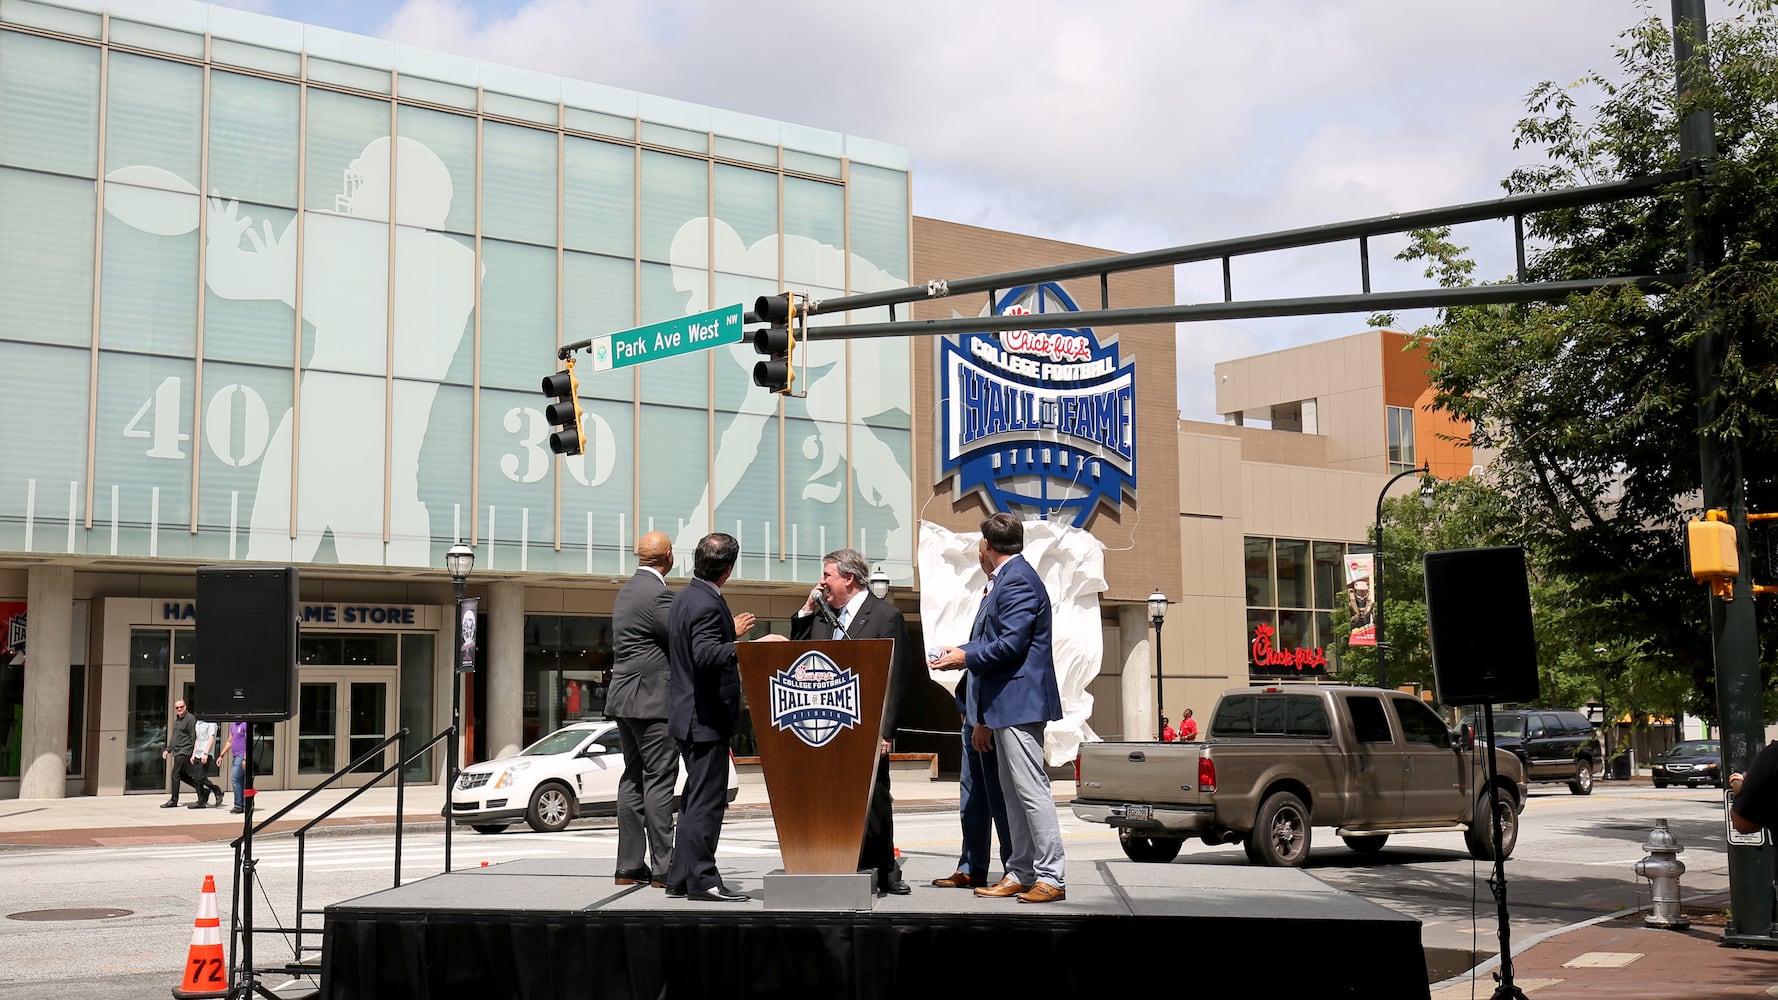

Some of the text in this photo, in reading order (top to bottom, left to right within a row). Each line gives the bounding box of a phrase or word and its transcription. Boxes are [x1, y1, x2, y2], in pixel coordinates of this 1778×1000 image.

[615, 313, 738, 360] Park Ave West NW
[971, 336, 1117, 381] COLLEGE FOOTBALL
[122, 376, 270, 467] 40
[959, 362, 1132, 461] HALL OF FAME
[500, 406, 617, 487] 30
[991, 447, 1101, 478] ATLANTA
[163, 602, 196, 621] HA
[343, 606, 416, 625] STORE
[1252, 633, 1328, 670] Chick-fil-A
[777, 686, 853, 713] HALL FAME
[782, 677, 846, 689] COLLEGE FOOTBALL
[192, 958, 222, 983] 72
